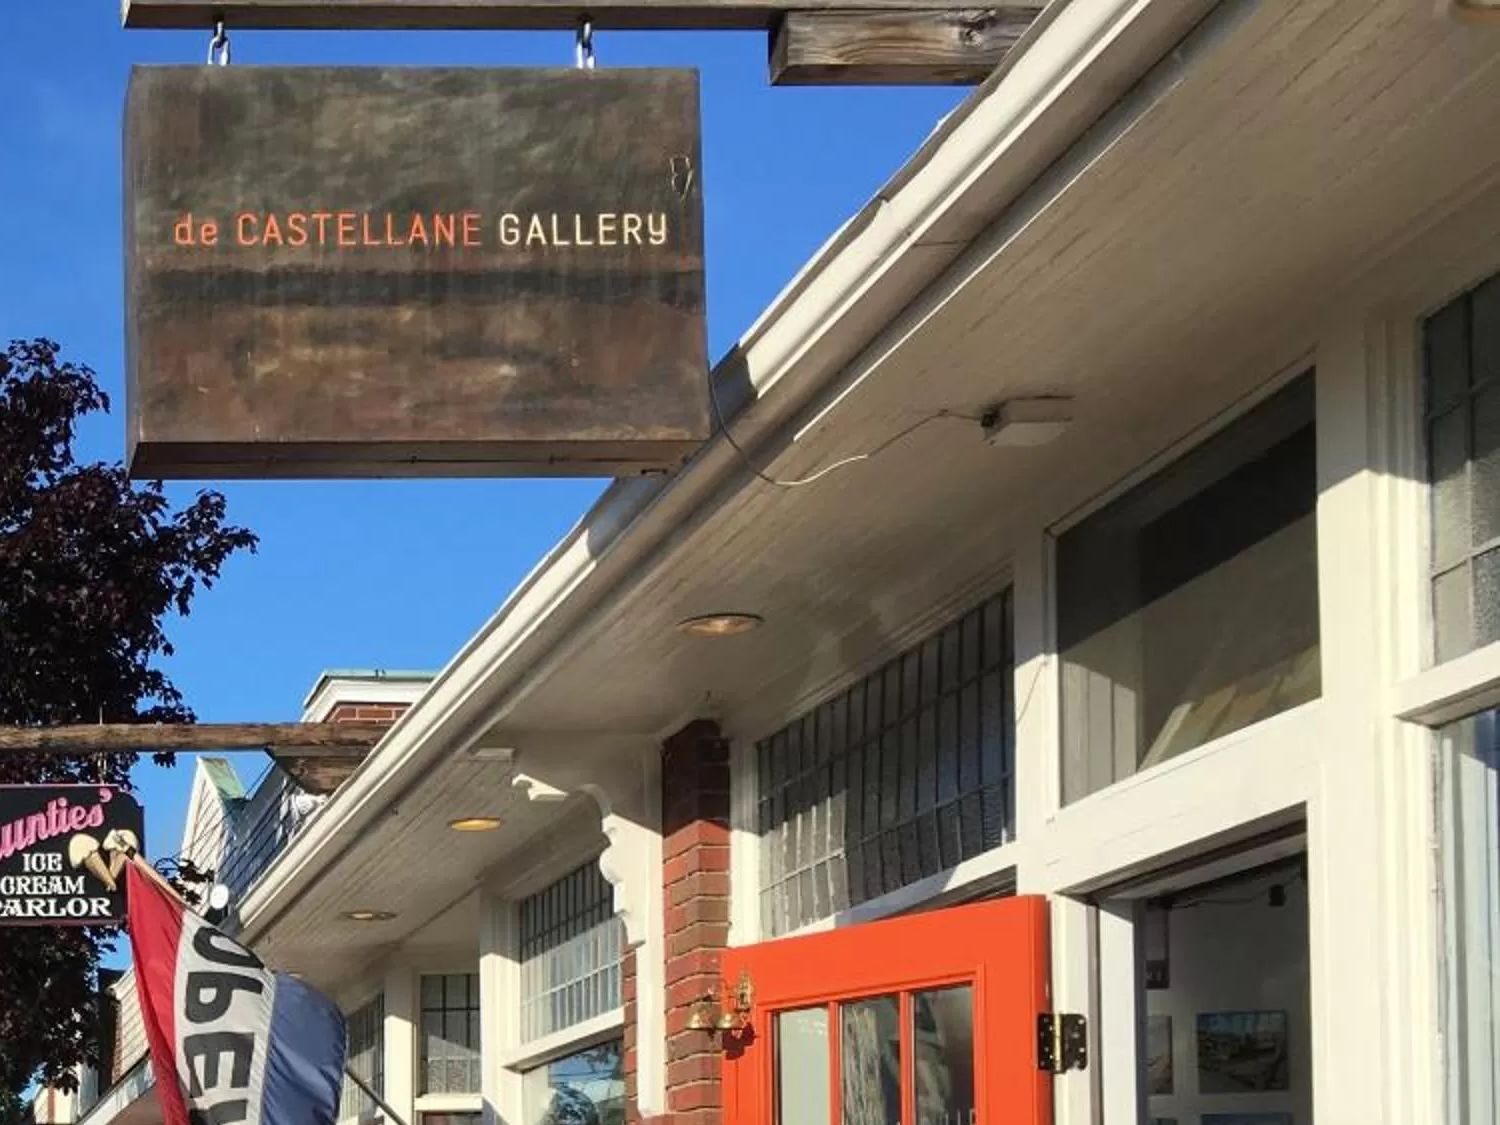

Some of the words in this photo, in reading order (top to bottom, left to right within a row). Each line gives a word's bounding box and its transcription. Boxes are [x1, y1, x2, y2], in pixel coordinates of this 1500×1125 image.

[174, 212, 218, 246] de
[236, 213, 482, 247] CASTELLANE
[499, 212, 667, 246] GALLERY
[22, 853, 63, 872] ICE
[0, 875, 85, 896] CREAM
